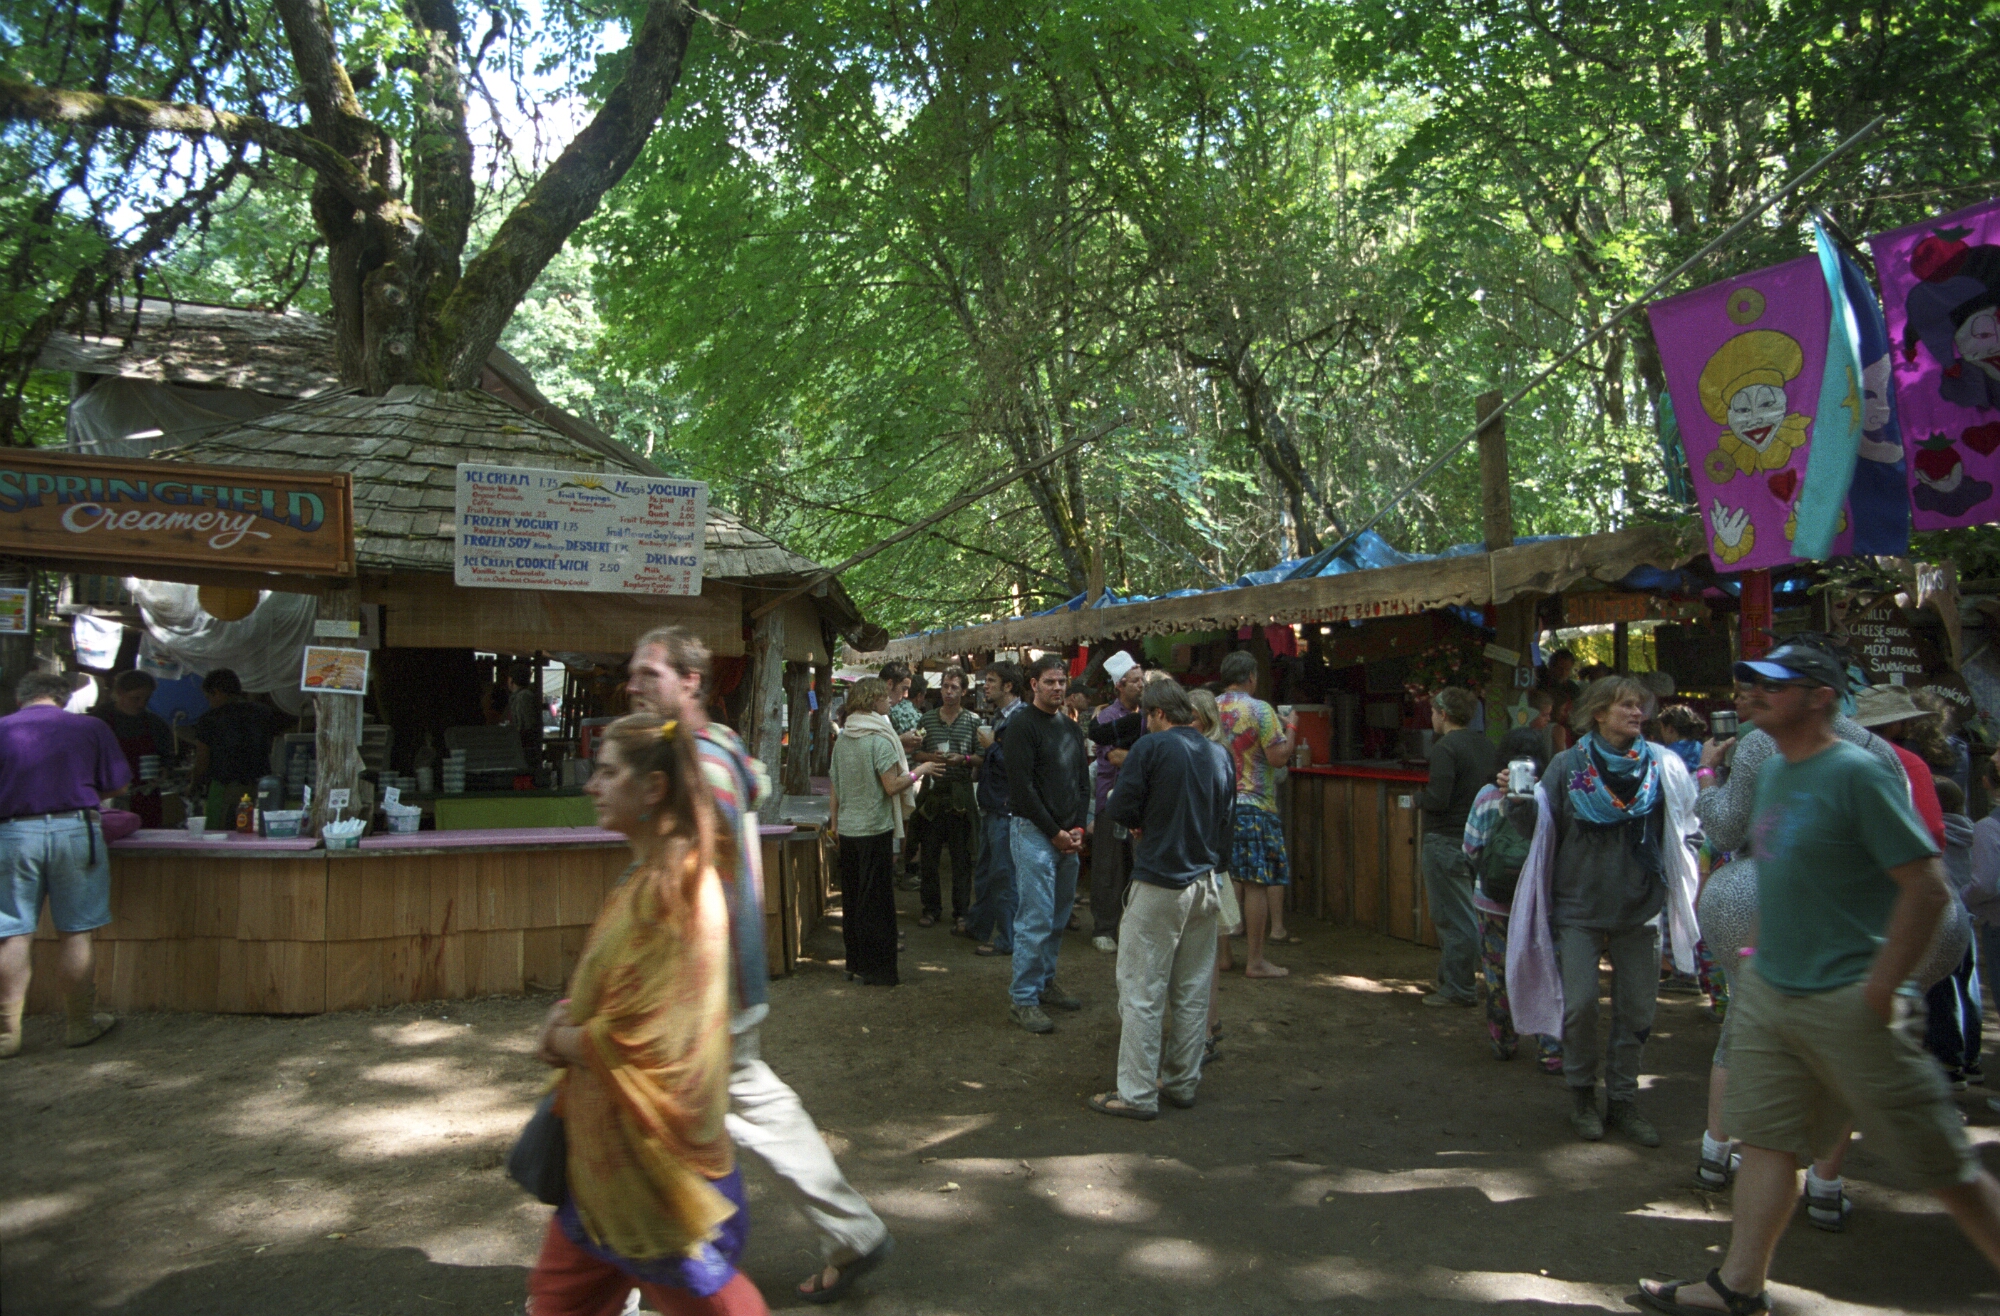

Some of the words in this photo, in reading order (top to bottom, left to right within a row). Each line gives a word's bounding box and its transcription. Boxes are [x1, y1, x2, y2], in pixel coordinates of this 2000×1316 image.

[465, 471, 483, 483] ICE
[487, 472, 530, 486] CREAM
[539, 477, 559, 488] 1.75
[498, 485, 519, 493] Vanilla
[647, 483, 698, 498] YOGURT
[0, 470, 325, 533] SPRINGFIELD
[472, 499, 494, 507] Coffee
[558, 490, 575, 499] Fruit
[577, 492, 611, 503] Toppings
[648, 510, 670, 518] Quart
[61, 502, 272, 549] Creamery
[464, 514, 511, 527] FROZEN
[514, 518, 560, 531] YOGURT
[620, 516, 638, 524] Fruit
[639, 517, 669, 527] Toppings
[473, 527, 506, 536] Raspberry
[507, 529, 537, 537] Chocolate
[537, 531, 552, 540] Chip
[606, 527, 623, 537] Fruit
[653, 529, 668, 542] Soy
[668, 531, 694, 542] Yogurt
[463, 534, 508, 548] FROZEN
[508, 537, 531, 549] SOY
[565, 540, 611, 553] DESSERT
[463, 555, 479, 567] ICE
[480, 556, 514, 569] CREAM
[600, 562, 620, 572] 2.50
[646, 553, 697, 566] DRINKS
[472, 566, 497, 575] Vanilla
[509, 569, 546, 577] Chocolate
[634, 573, 657, 583] Organic
[492, 576, 522, 584] Oatmeal
[523, 577, 553, 585] Chocolate
[553, 578, 567, 587] Chip
[568, 579, 589, 587] Cookie
[1300, 605, 1348, 623] BLINTZ
[1355, 600, 1399, 619] BOOTH
[1567, 597, 1646, 624] BLINTZES
[1849, 624, 1885, 637] CHEESE
[1885, 627, 1910, 637] STEAK
[1863, 644, 1888, 656] MEXI
[1890, 646, 1918, 658] STEAK
